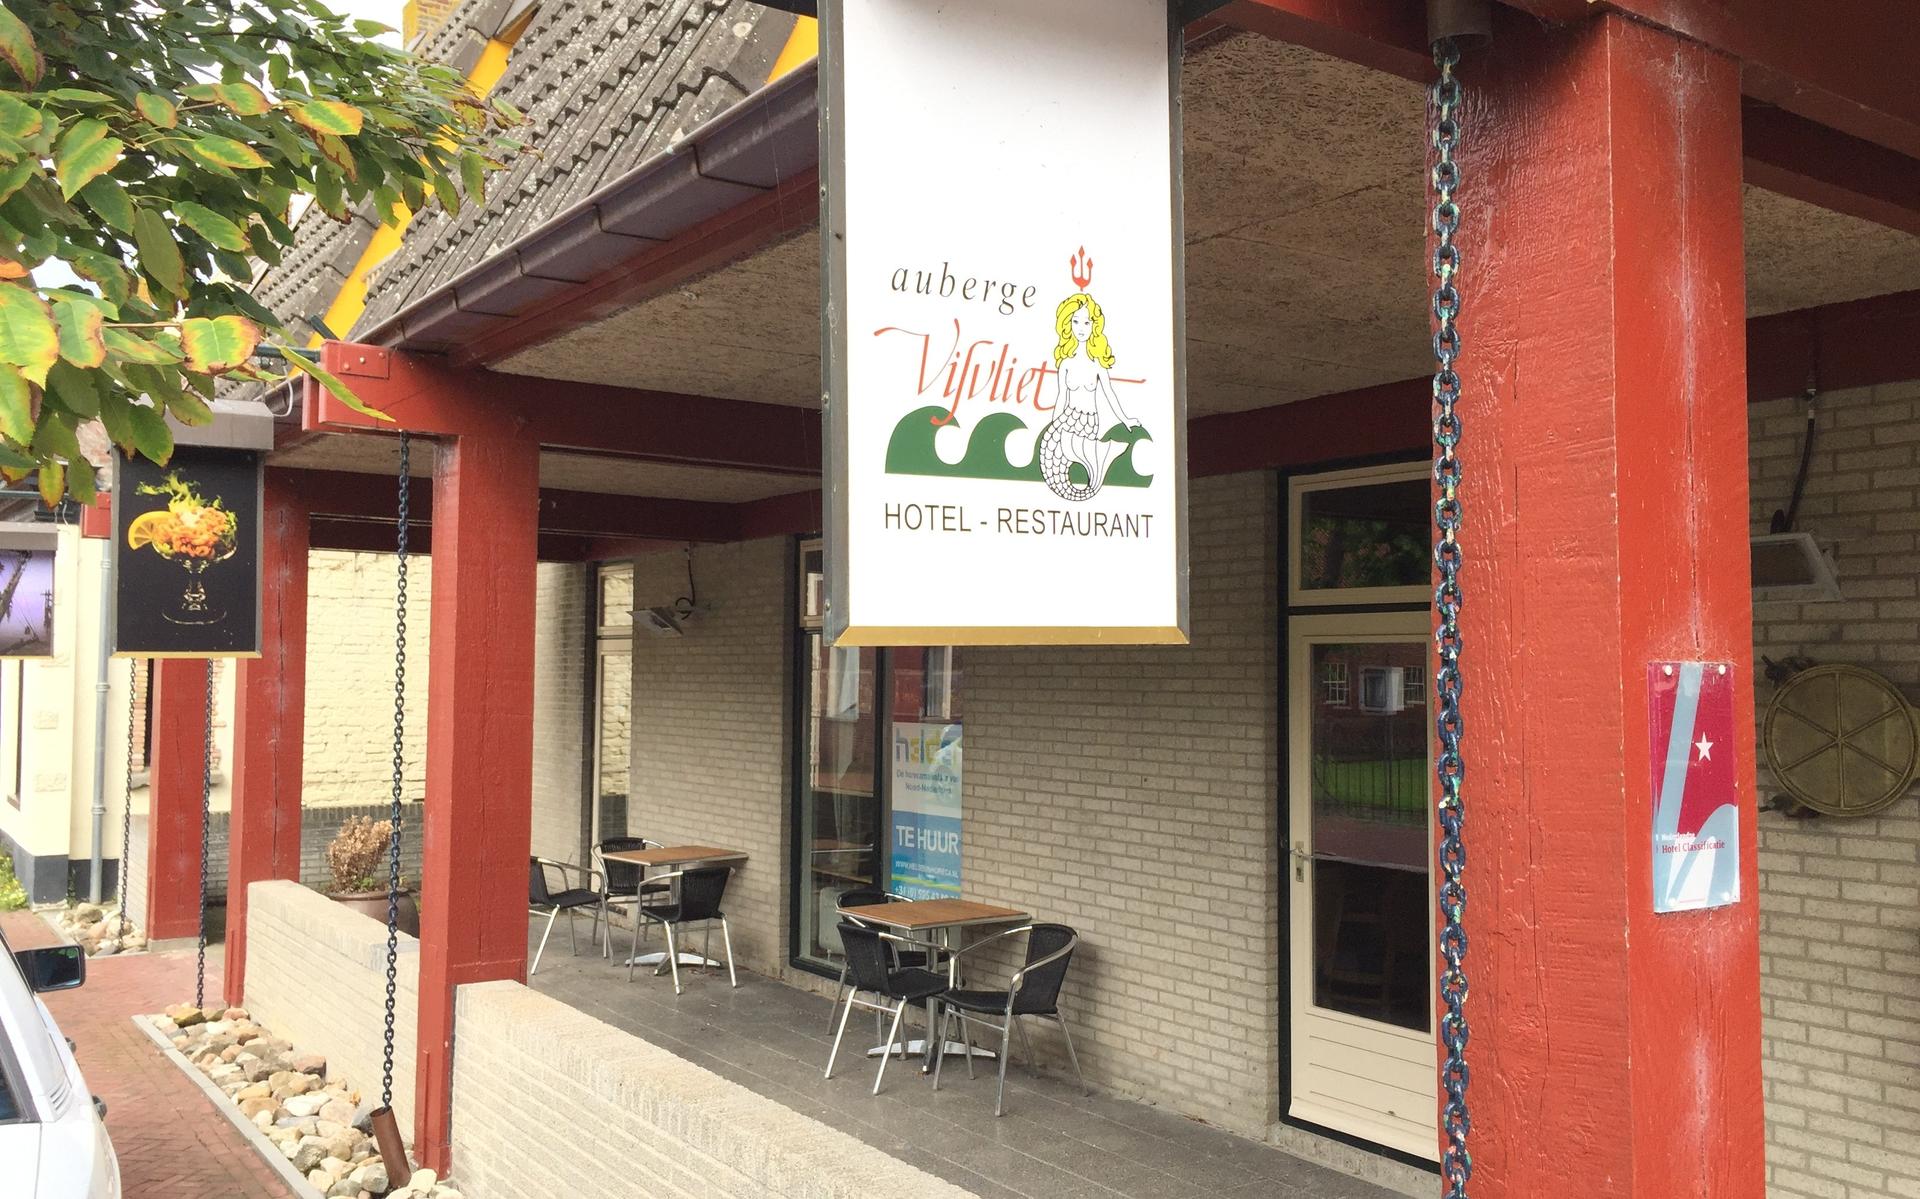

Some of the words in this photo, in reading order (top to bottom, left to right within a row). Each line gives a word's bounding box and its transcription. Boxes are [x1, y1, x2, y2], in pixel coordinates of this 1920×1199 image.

[891, 261, 1036, 315] auberge
[885, 503, 972, 532] HOTEL
[998, 508, 1154, 538] RESTAURANT
[895, 825, 915, 848] TE
[917, 828, 959, 855] HUUR
[1662, 843, 1681, 854] Hotel
[1683, 840, 1725, 851] Classificatie
